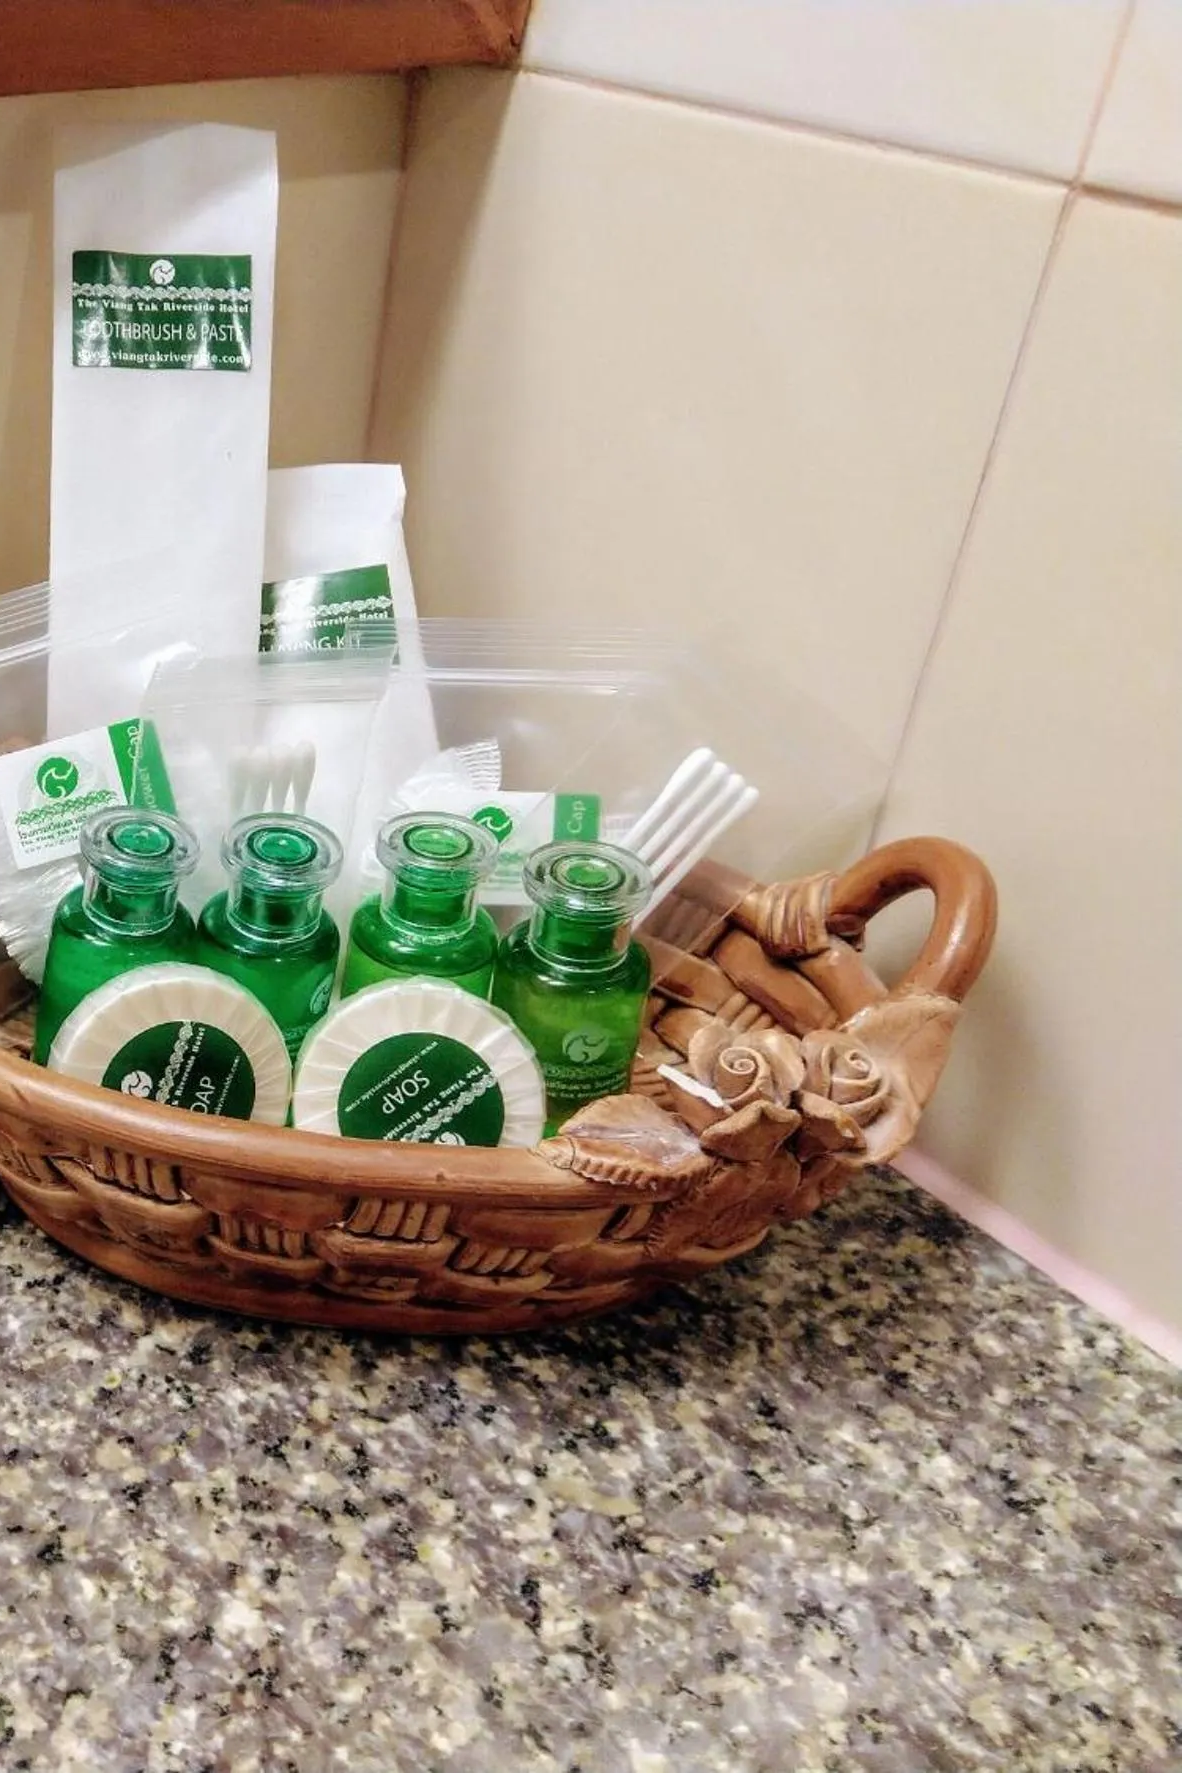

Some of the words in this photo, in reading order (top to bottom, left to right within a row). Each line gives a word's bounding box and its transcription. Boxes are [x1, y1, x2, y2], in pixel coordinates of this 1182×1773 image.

[77, 298, 97, 308] The
[102, 299, 133, 312] Viang
[137, 302, 159, 311] Tak
[163, 301, 215, 312] Riverside
[219, 302, 249, 313] Hotel
[186, 323, 197, 341] &
[567, 800, 586, 833] Cap
[466, 1065, 485, 1080] The
[190, 1076, 215, 1114] OAP
[382, 1069, 431, 1115] SOAP
[439, 1079, 467, 1099] Viang
[422, 1098, 442, 1113] Tak
